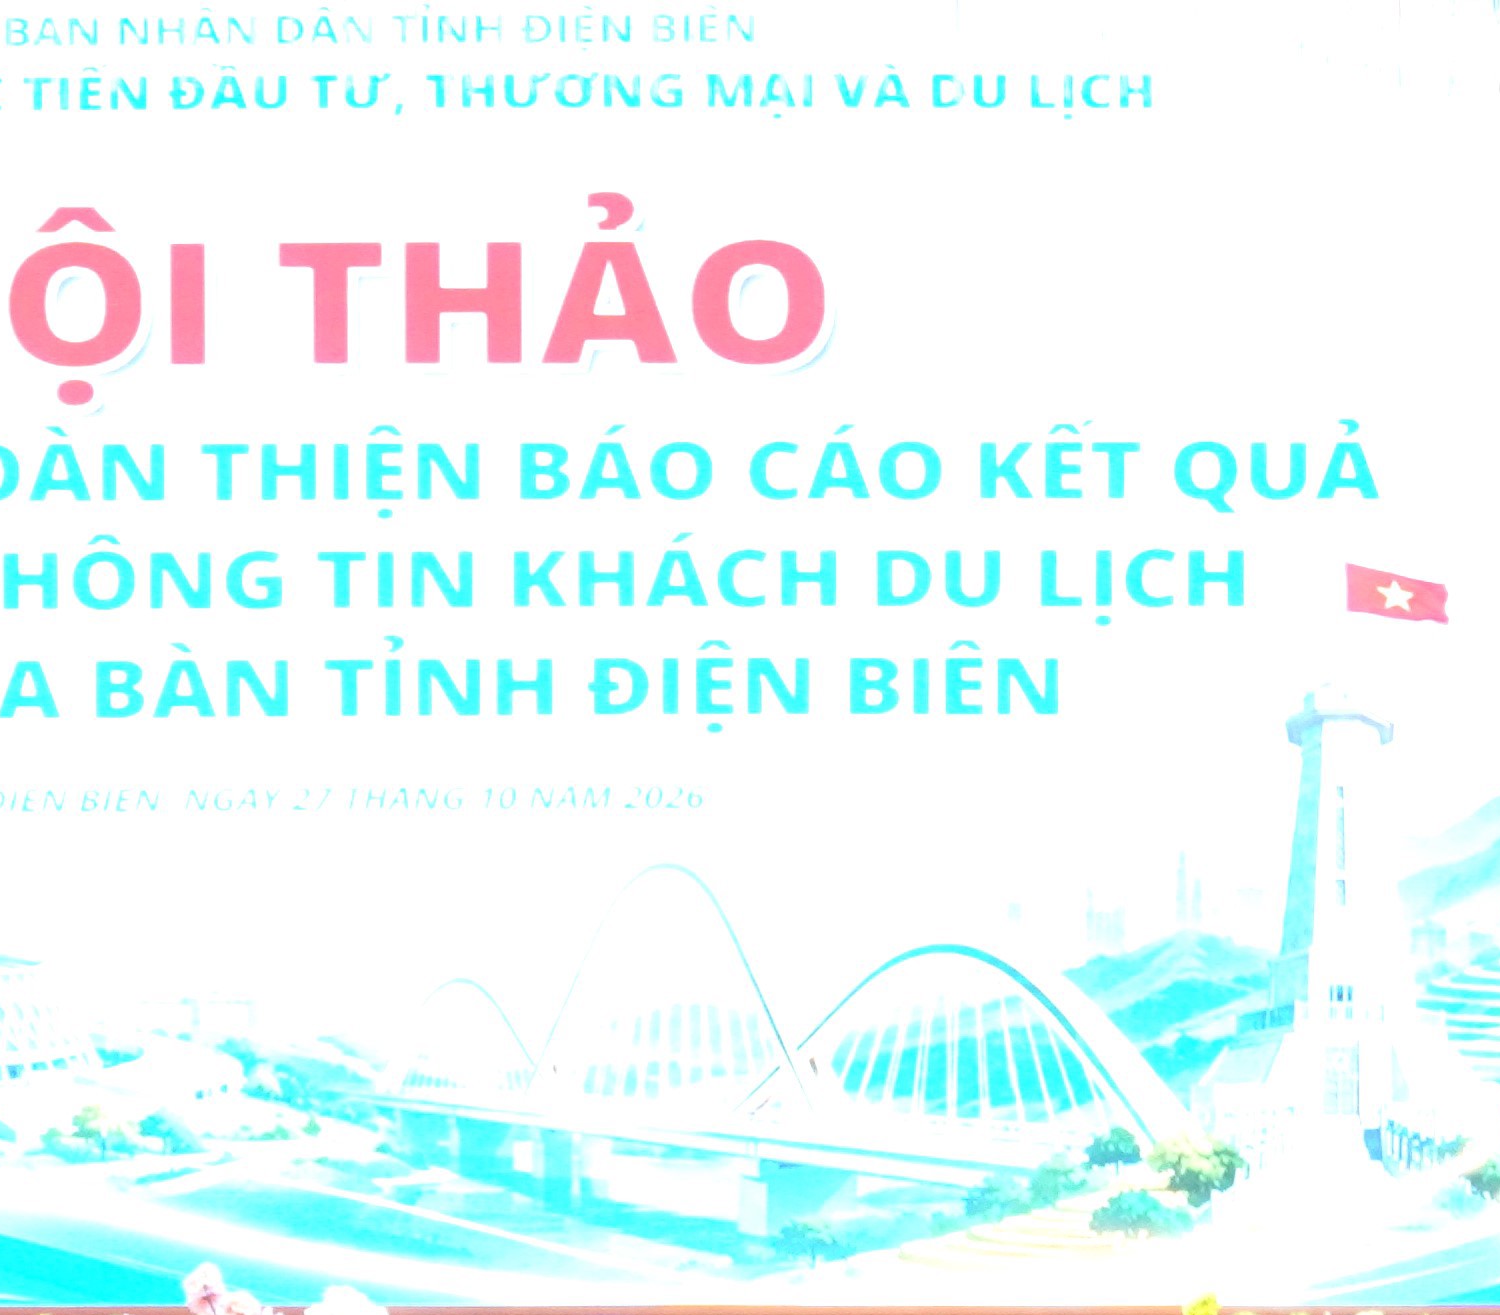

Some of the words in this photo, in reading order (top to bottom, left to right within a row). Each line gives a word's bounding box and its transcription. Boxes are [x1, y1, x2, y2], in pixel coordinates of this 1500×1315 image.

[5, 17, 99, 47] BAN
[312, 72, 404, 115] TƯ,
[426, 72, 683, 109] THƯƠNG
[706, 73, 813, 119] MẠI
[835, 64, 911, 109] VÀ
[931, 73, 1007, 109] DU
[1030, 74, 1154, 120] LỊCH
[279, 191, 827, 366] THẢO
[201, 425, 480, 519] THIỆN
[520, 424, 713, 501] BÁO
[749, 424, 942, 500] CÁO
[980, 420, 1140, 499] KẾT
[1174, 419, 1380, 513] QUẢ
[317, 551, 473, 608] TIN
[513, 534, 837, 607] KHÁCH
[877, 550, 1001, 608] DU
[1040, 549, 1246, 626] LỊCH
[96, 643, 289, 718] BÀN
[325, 636, 553, 717] TỈNH
[588, 641, 809, 733] ĐIỆN
[849, 641, 1060, 715] BIÊN
